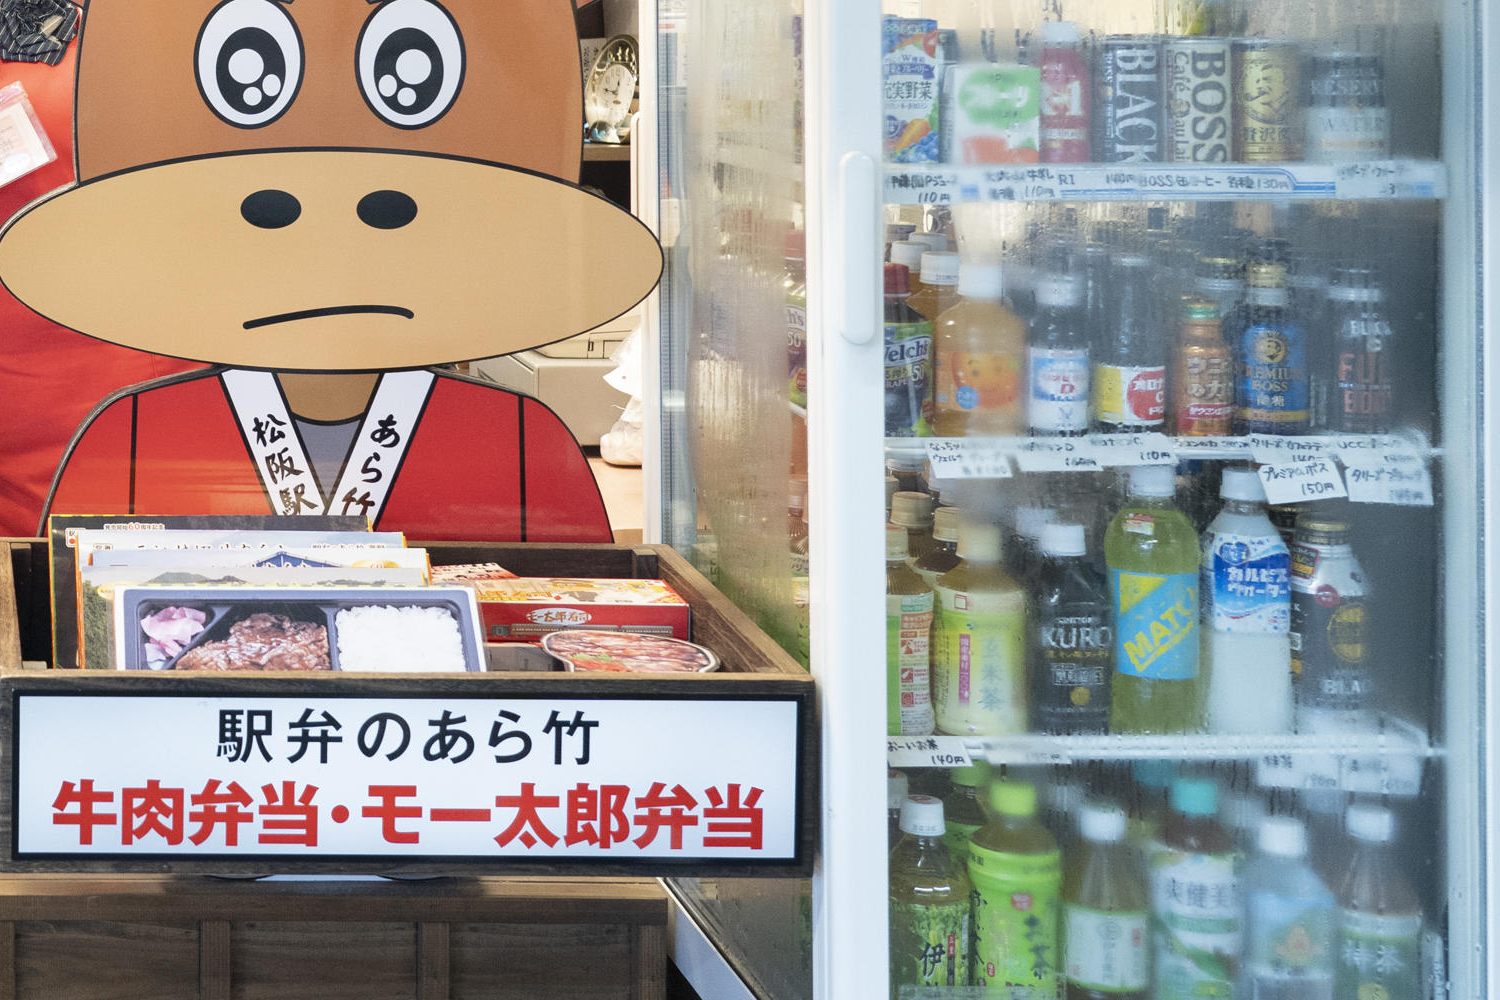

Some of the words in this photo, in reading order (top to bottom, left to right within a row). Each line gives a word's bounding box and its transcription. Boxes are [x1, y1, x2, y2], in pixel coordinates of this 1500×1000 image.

[1191, 49, 1227, 163] BOSS
[252, 413, 319, 516] 松阪駅
[341, 414, 401, 516] あら竹
[1301, 482, 1335, 497] 150円
[216, 708, 601, 766] 駅弁のあら竹
[930, 753, 966, 766] 140円
[52, 779, 764, 850] 牛肉弁当・モー太郎弁当
